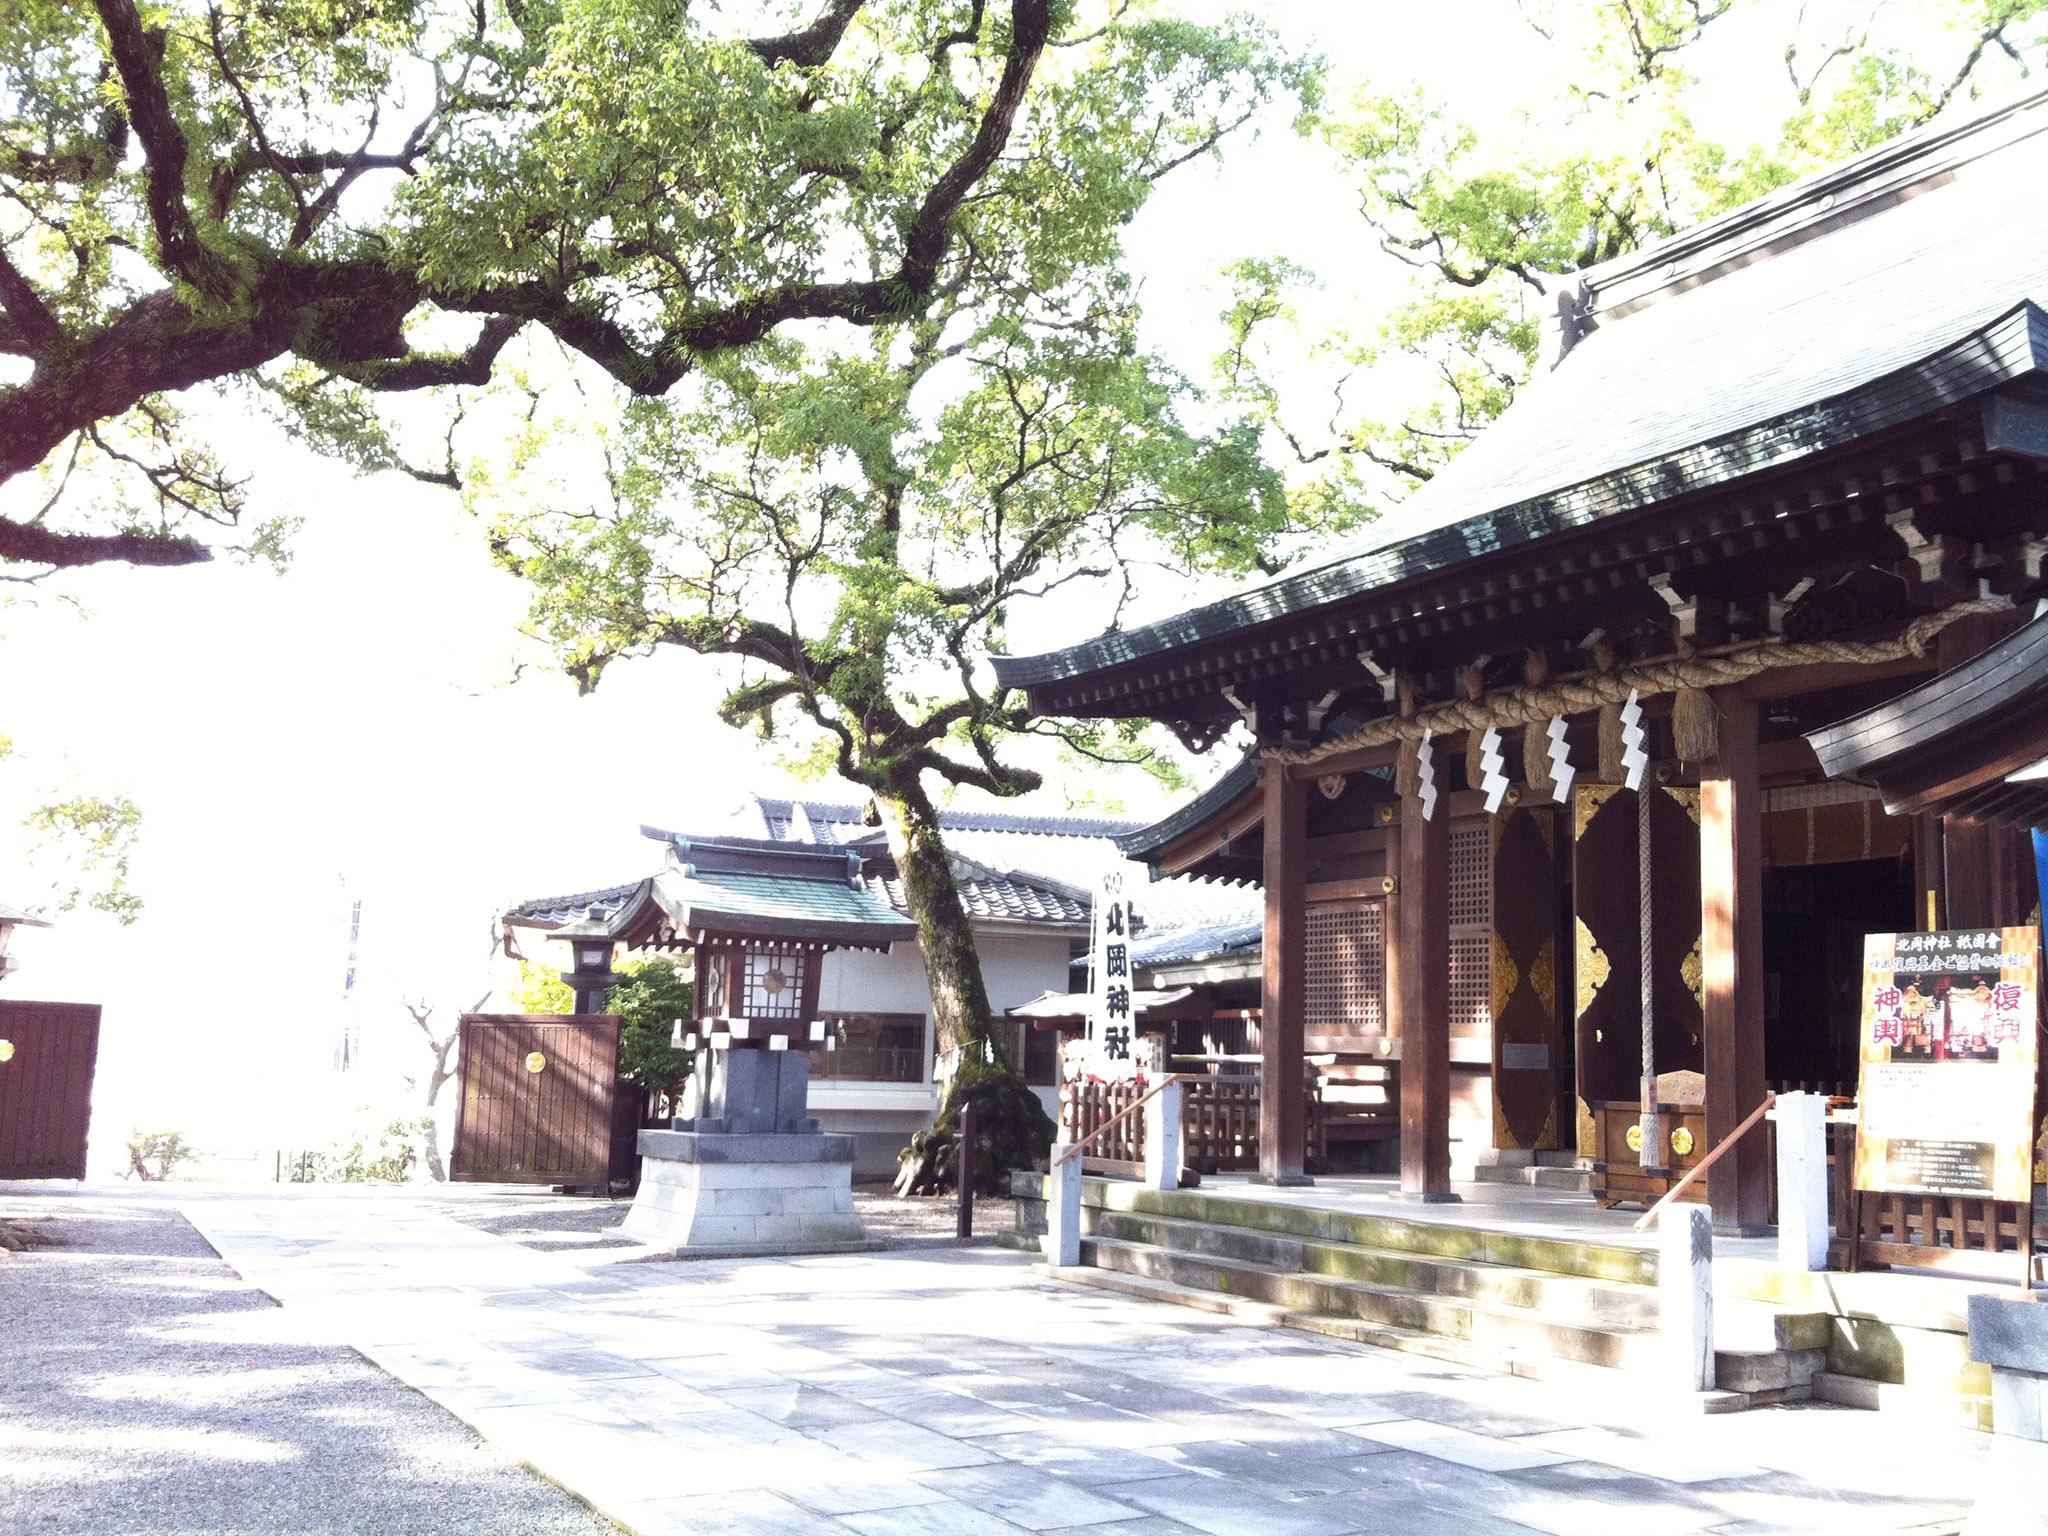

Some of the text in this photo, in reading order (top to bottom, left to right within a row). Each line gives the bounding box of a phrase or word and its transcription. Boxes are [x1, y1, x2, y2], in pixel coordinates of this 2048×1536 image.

[1896, 934, 1952, 952] 北岡神社
[1104, 902, 1130, 1060] 北岡神社
[1873, 986, 1902, 1045] 神輿
[1993, 983, 2022, 1045] 復興
